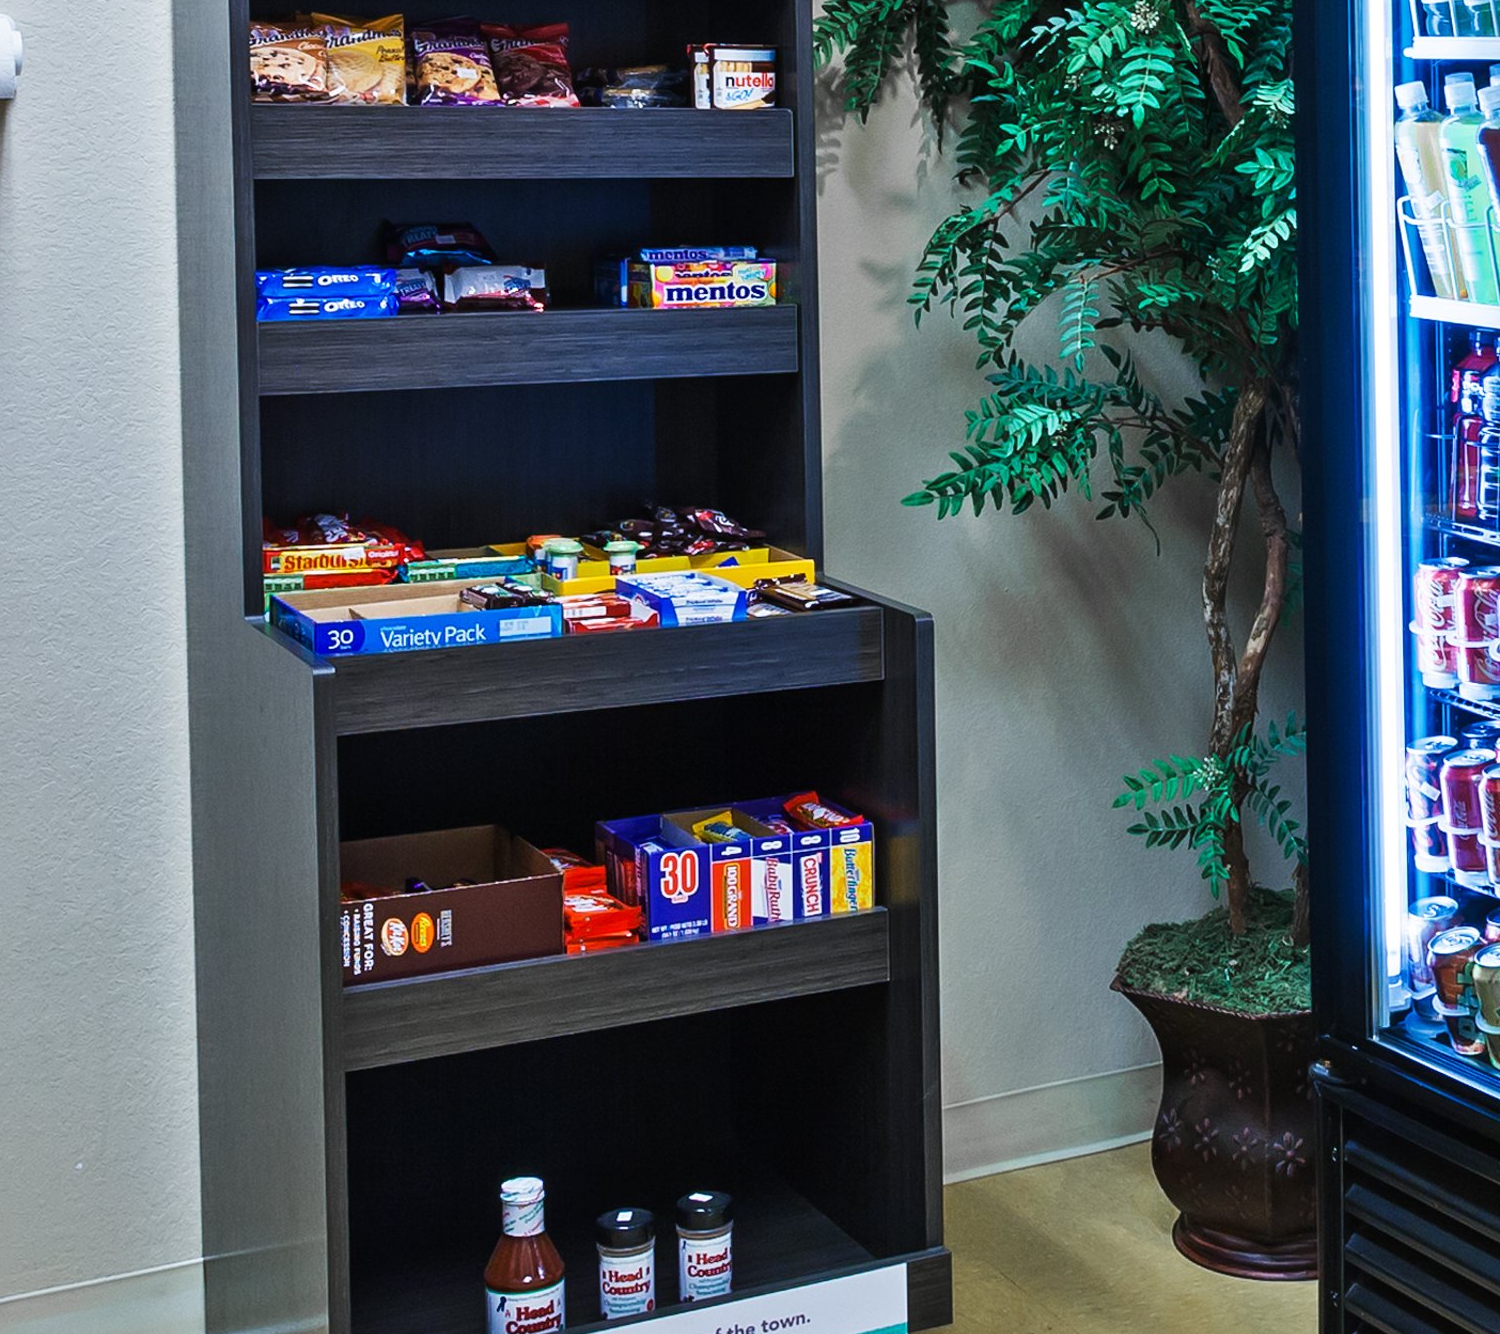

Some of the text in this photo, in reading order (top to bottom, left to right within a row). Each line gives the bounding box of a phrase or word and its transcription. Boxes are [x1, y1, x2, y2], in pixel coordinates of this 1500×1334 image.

[725, 72, 773, 88] nutella
[649, 249, 707, 260] mentos
[317, 273, 360, 286] OREO
[665, 282, 766, 302] mentos
[323, 299, 366, 313] OREO
[327, 629, 354, 650] 30
[380, 623, 486, 652] Variety Pack
[660, 850, 699, 899] 30
[803, 857, 821, 914] CRUNCH
[696, 1250, 728, 1266] Head
[609, 1267, 644, 1283] Head
[687, 1261, 733, 1278] Country
[602, 1280, 651, 1296] Country
[516, 1300, 555, 1322] Head
[760, 1312, 812, 1334] town.
